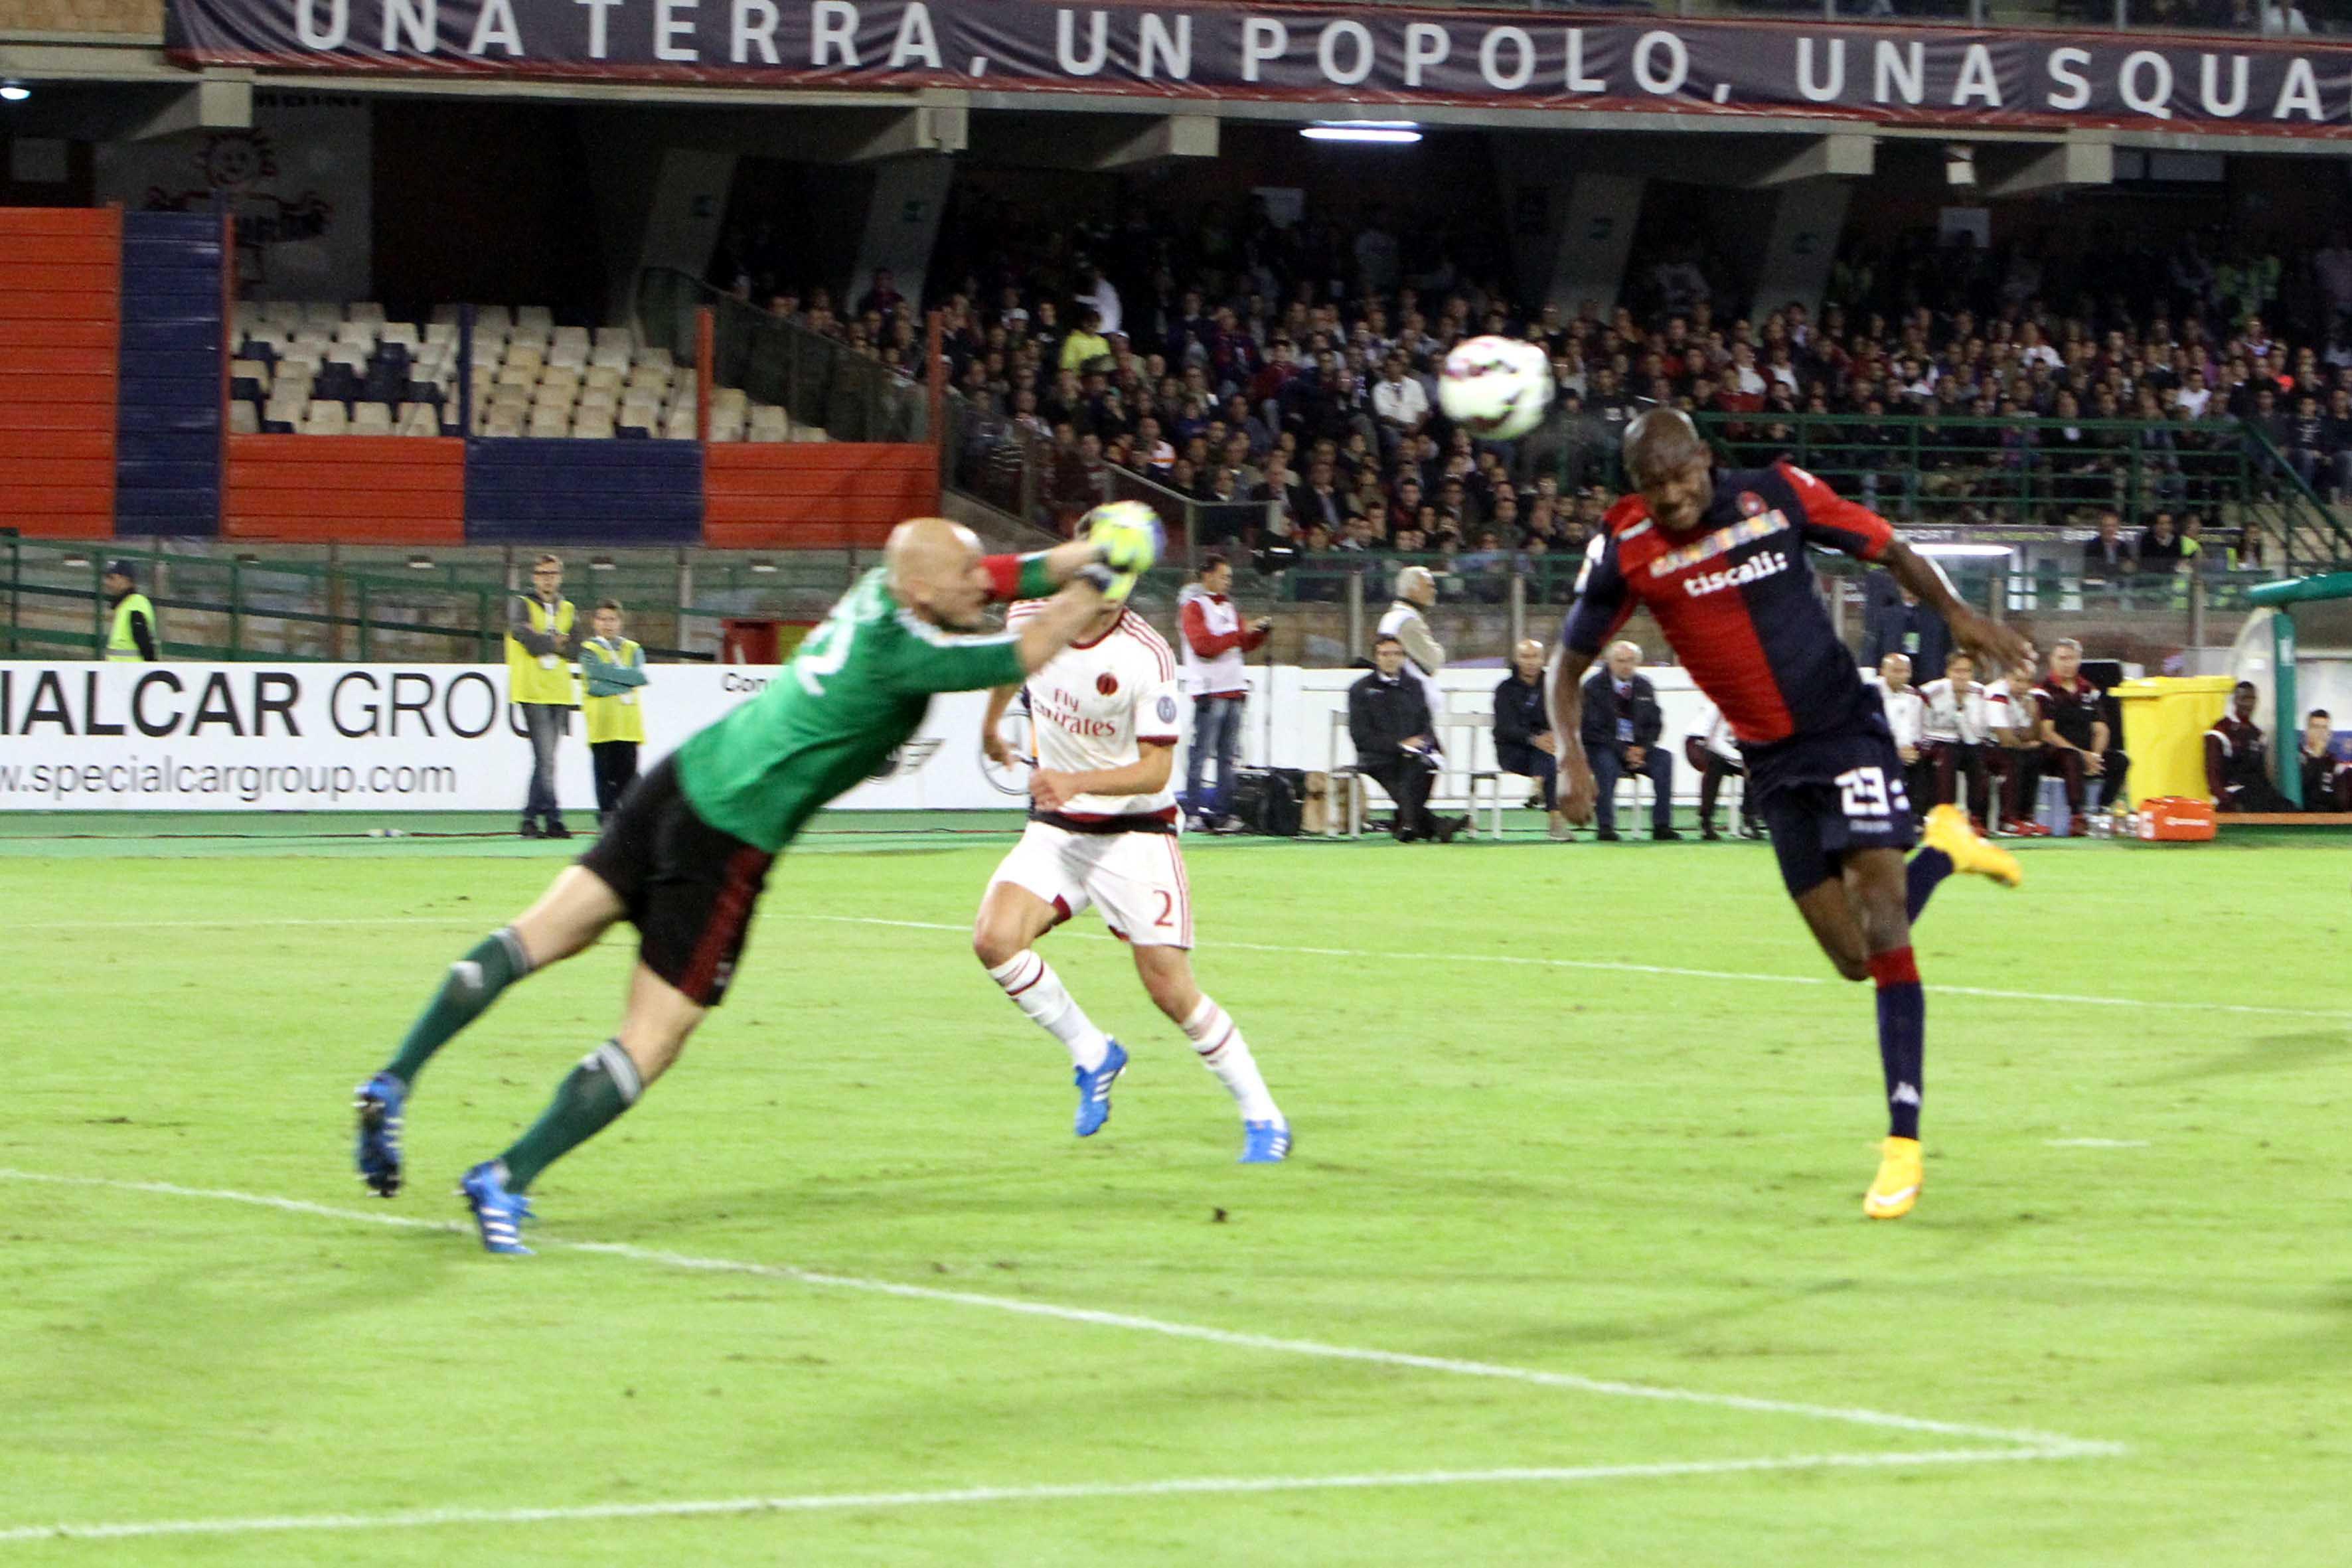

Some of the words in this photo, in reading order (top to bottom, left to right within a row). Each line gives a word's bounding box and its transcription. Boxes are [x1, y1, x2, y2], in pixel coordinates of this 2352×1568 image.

[295, 0, 525, 56] UNA
[576, 0, 988, 77] TERRA,
[1056, 9, 1192, 80] UN
[1241, 17, 1731, 104] POPOLO,
[1796, 37, 2003, 107] UNA
[0, 670, 302, 737] IALCAR
[329, 671, 581, 738] GRO
[1054, 688, 1079, 712] Fly
[1153, 890, 1174, 927] 2
